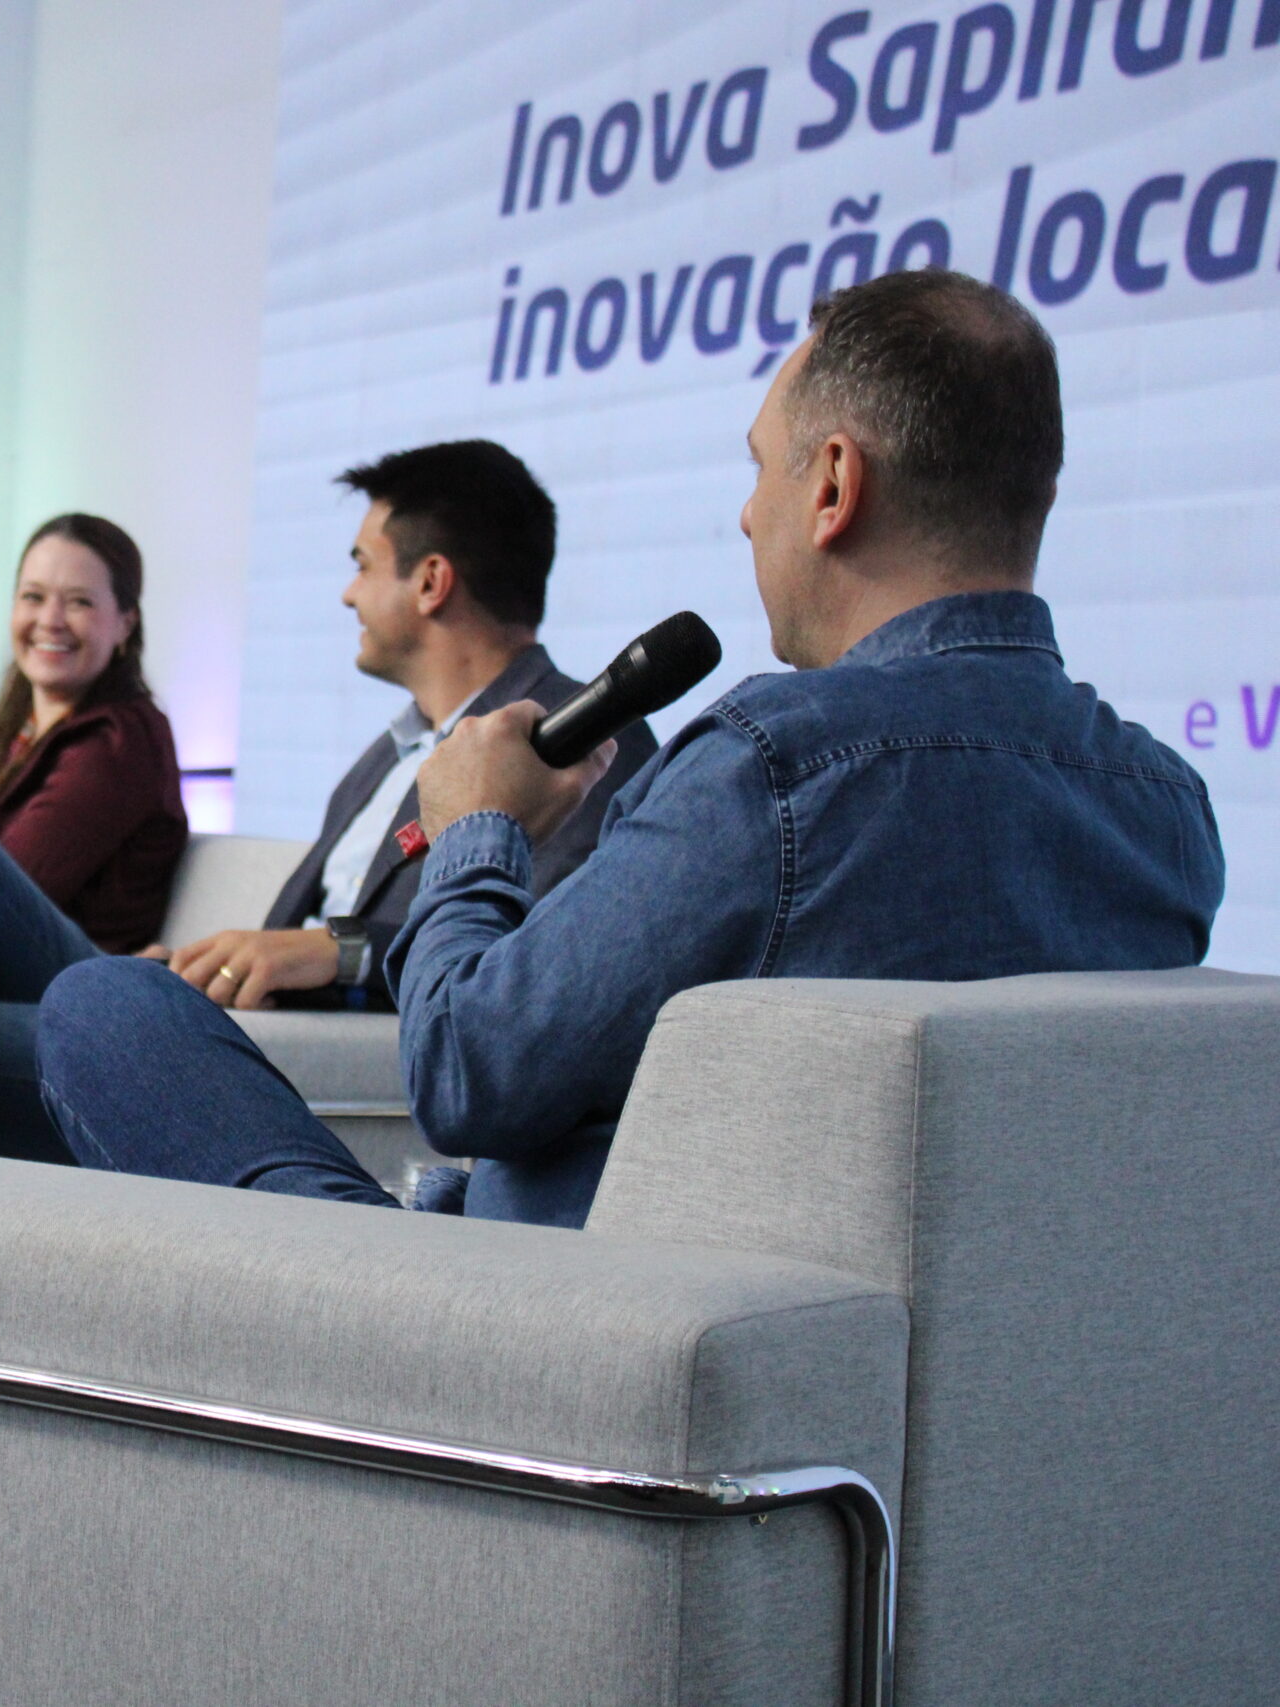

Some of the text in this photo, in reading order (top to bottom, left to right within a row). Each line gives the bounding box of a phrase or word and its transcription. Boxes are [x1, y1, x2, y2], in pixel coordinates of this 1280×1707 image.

[501, 67, 768, 217] Inova
[991, 159, 1280, 306] loca
[1185, 701, 1216, 748] e
